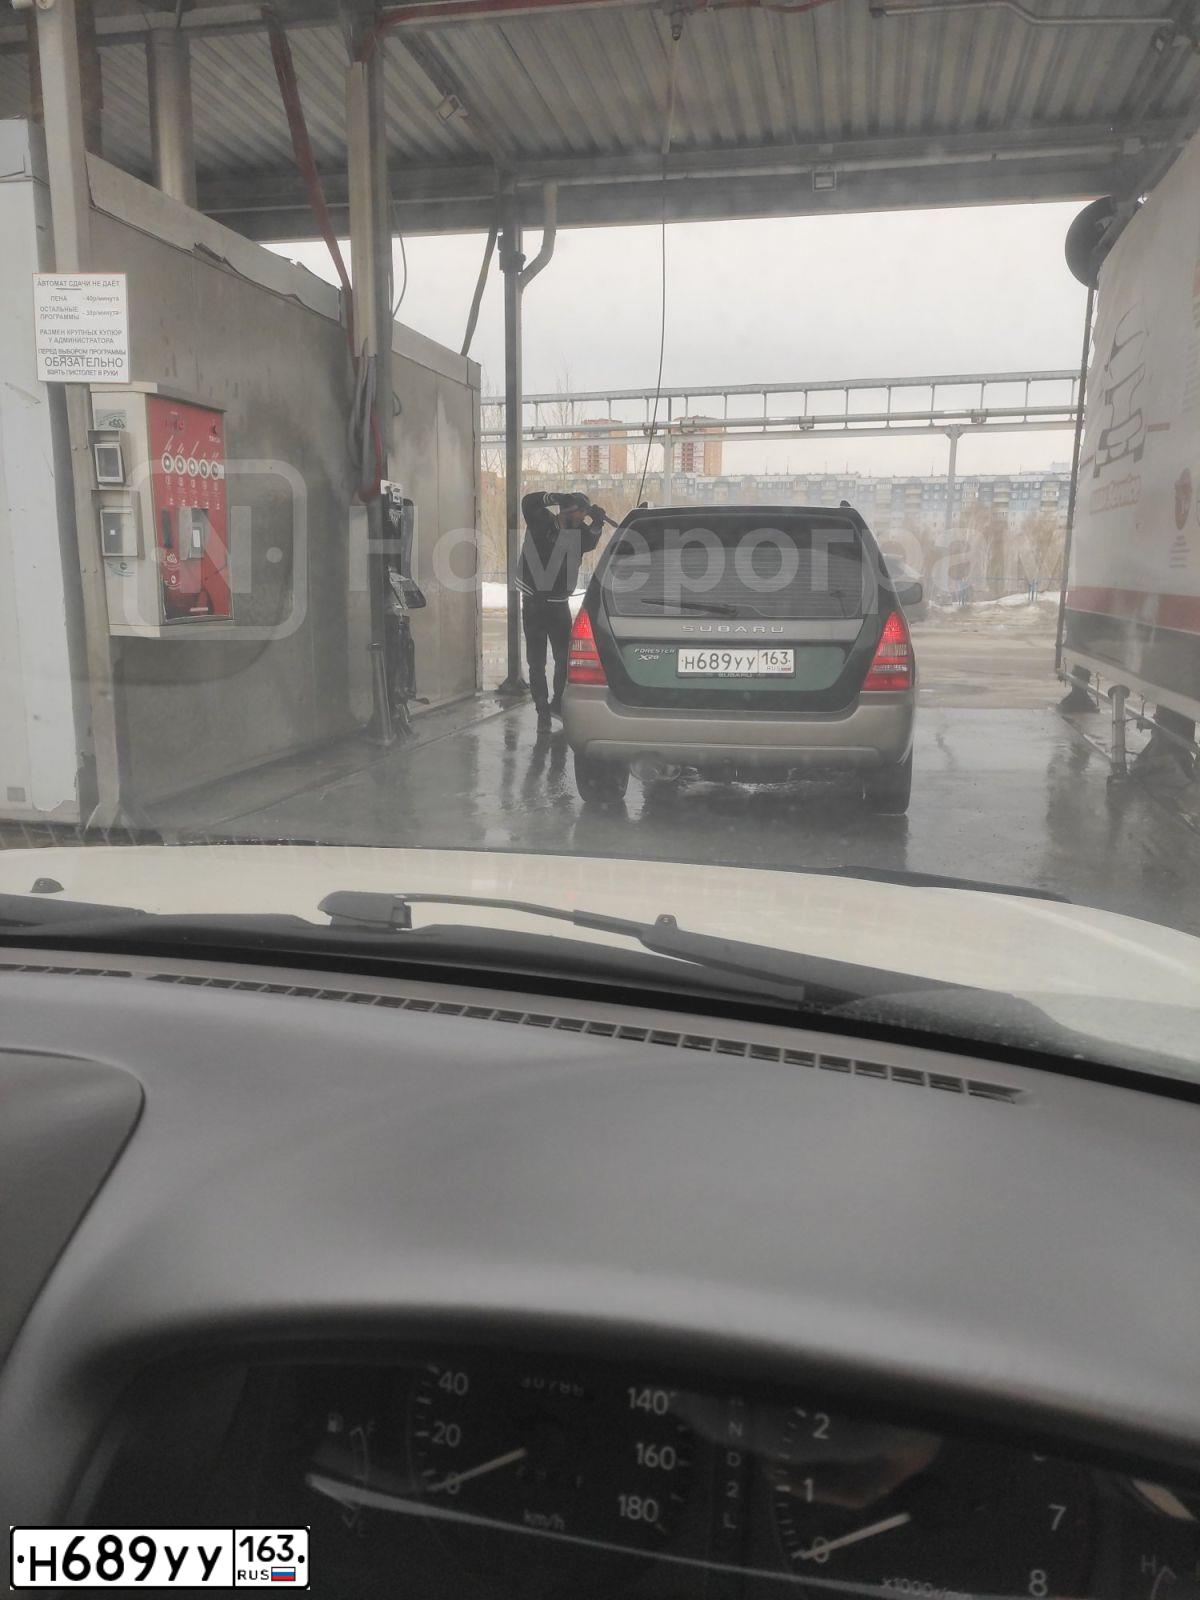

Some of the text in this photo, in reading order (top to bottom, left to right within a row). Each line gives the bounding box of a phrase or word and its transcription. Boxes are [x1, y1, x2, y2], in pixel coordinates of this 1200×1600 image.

[39, 328, 66, 336] РАЗМЕН
[45, 356, 123, 367] ОБЯЗАТЕЛЬНО
[681, 625, 785, 634] SUBARU
[761, 651, 789, 666] 163
[438, 1370, 468, 1397] 40
[627, 1386, 670, 1416] 140
[431, 1421, 462, 1449] 20
[728, 1420, 743, 1437] N
[812, 1412, 831, 1440] 2
[635, 1441, 676, 1471] 160
[726, 1452, 741, 1467] D
[803, 1478, 814, 1503] 1
[617, 1494, 659, 1524] 180
[1047, 1503, 1067, 1531] 7
[1140, 1554, 1156, 1575] H
[1028, 1569, 1048, 1597] 8
